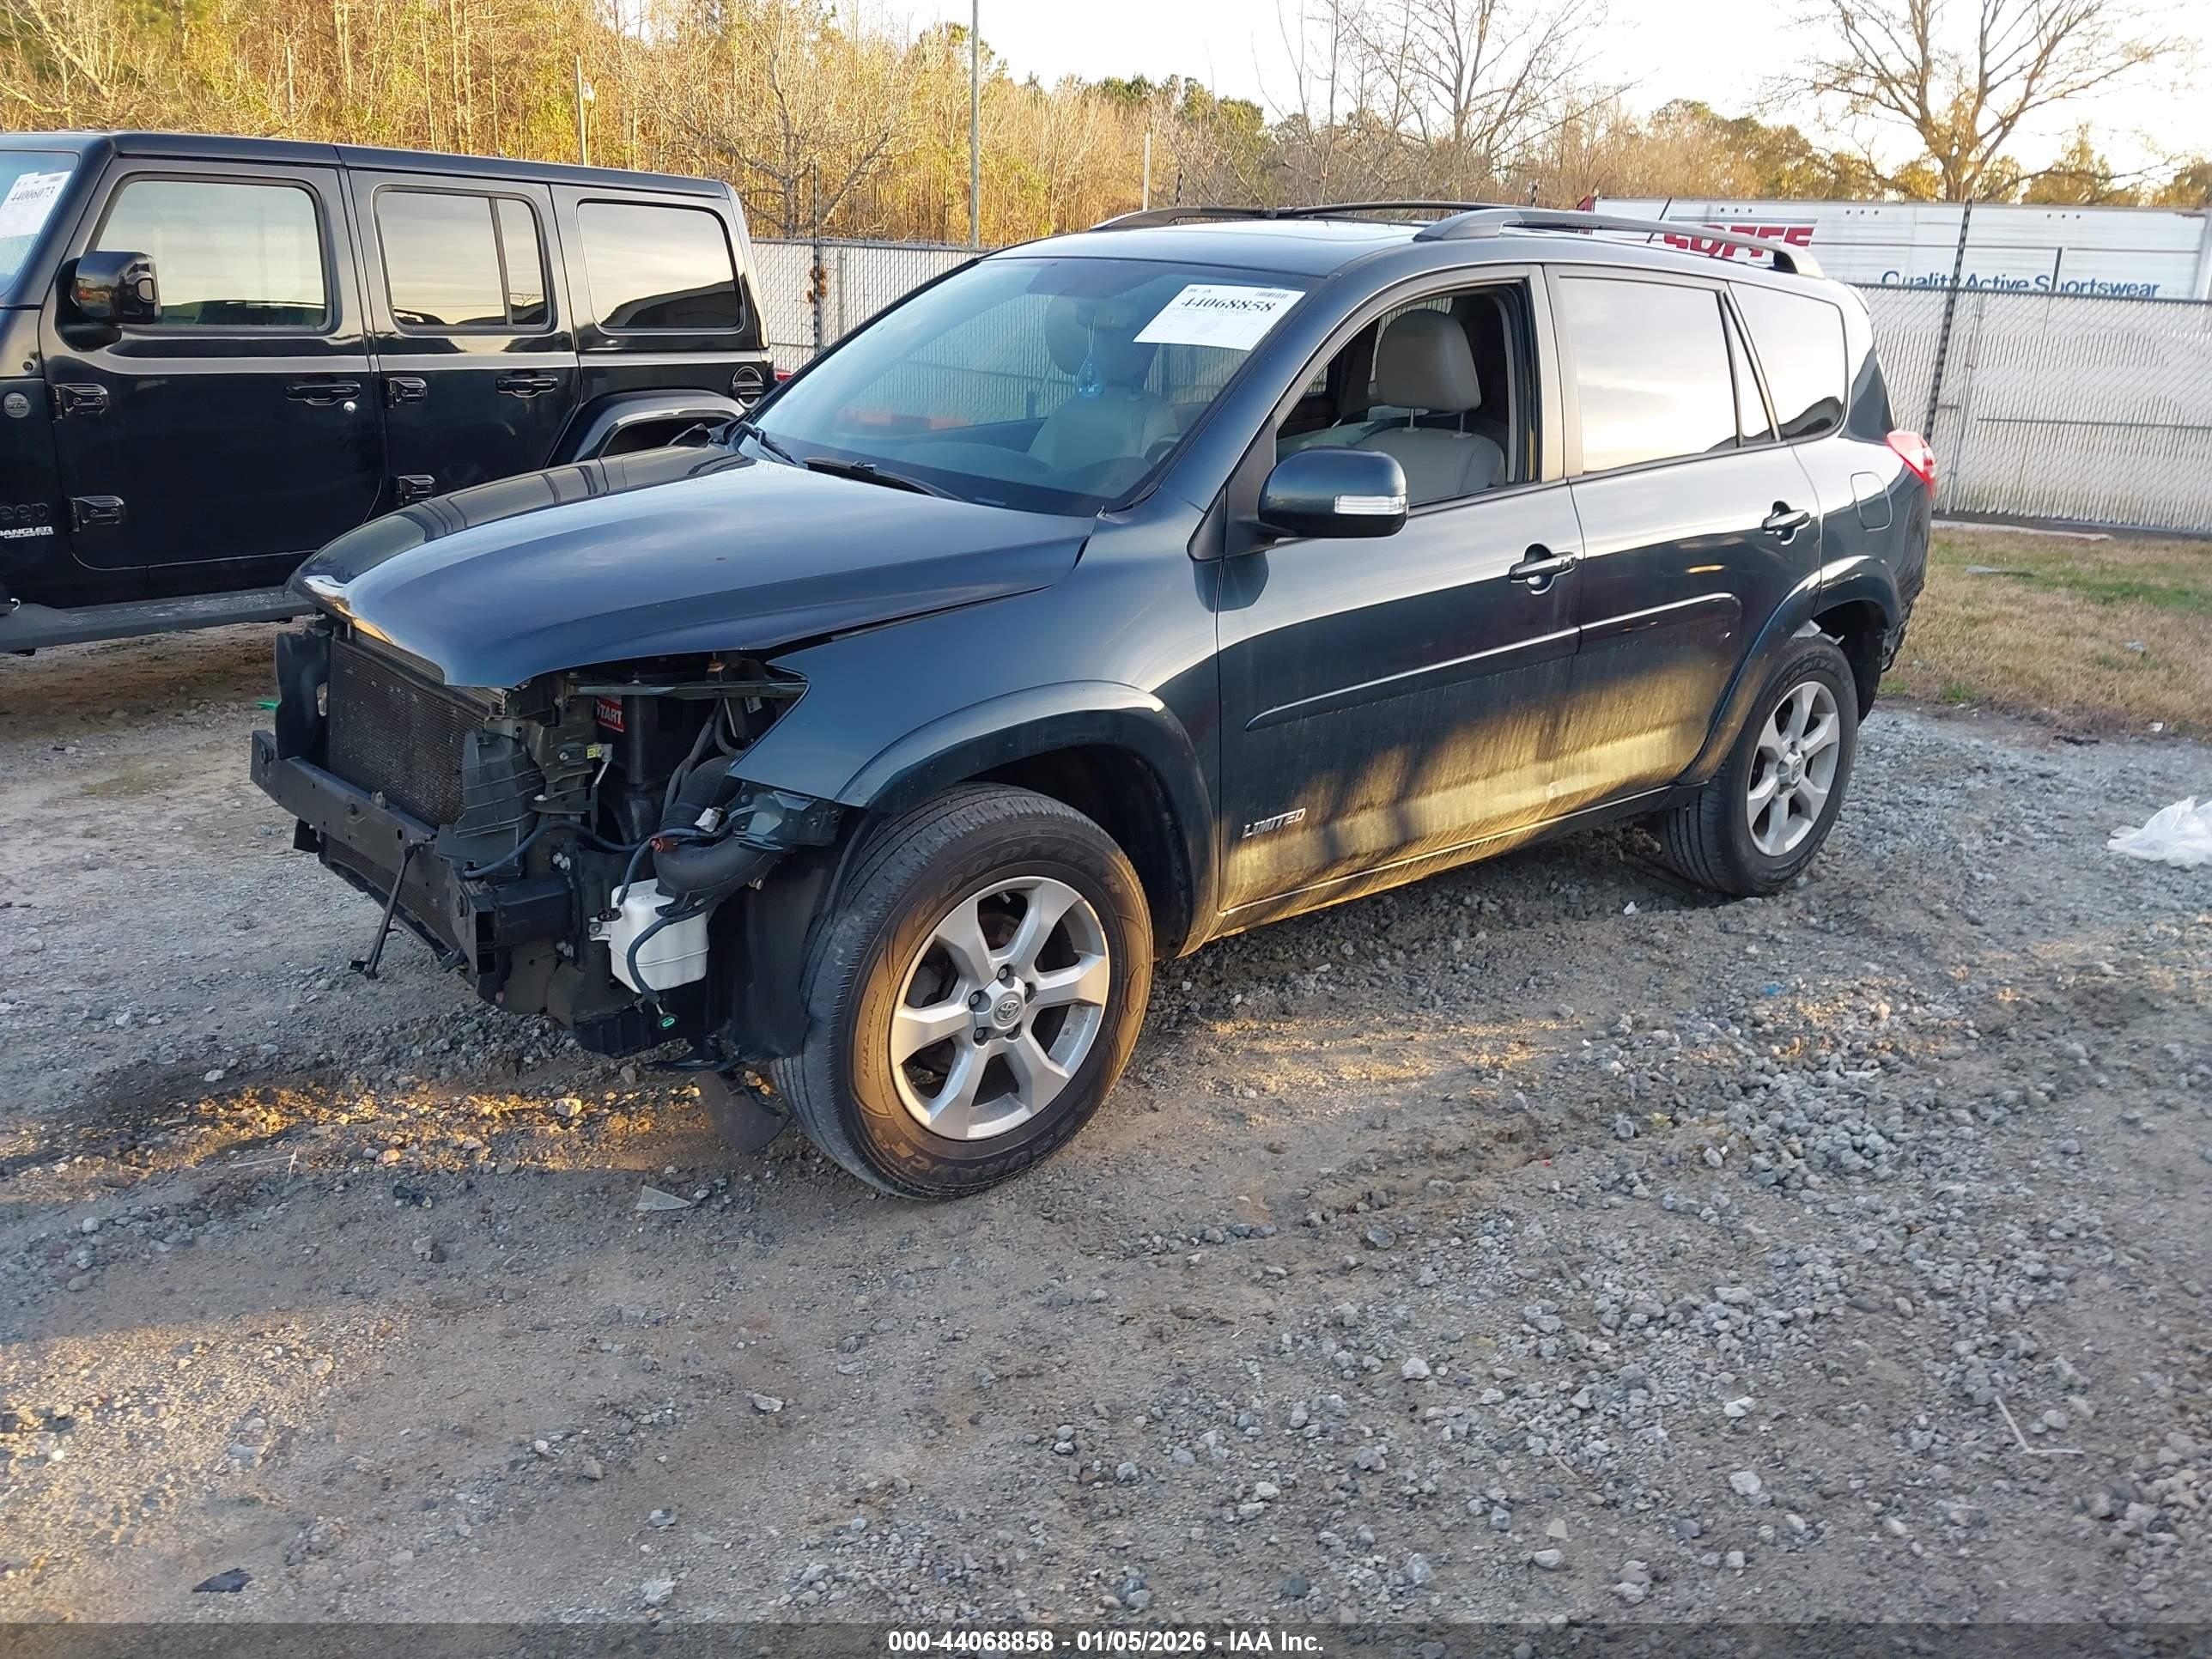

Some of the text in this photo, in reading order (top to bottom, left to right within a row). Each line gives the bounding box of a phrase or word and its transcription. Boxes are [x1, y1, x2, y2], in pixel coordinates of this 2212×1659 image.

[1881, 270, 2160, 297] Qualit Active Sortswear
[1181, 297, 1276, 313] 44068858
[1241, 808, 1306, 839] LIMITED
